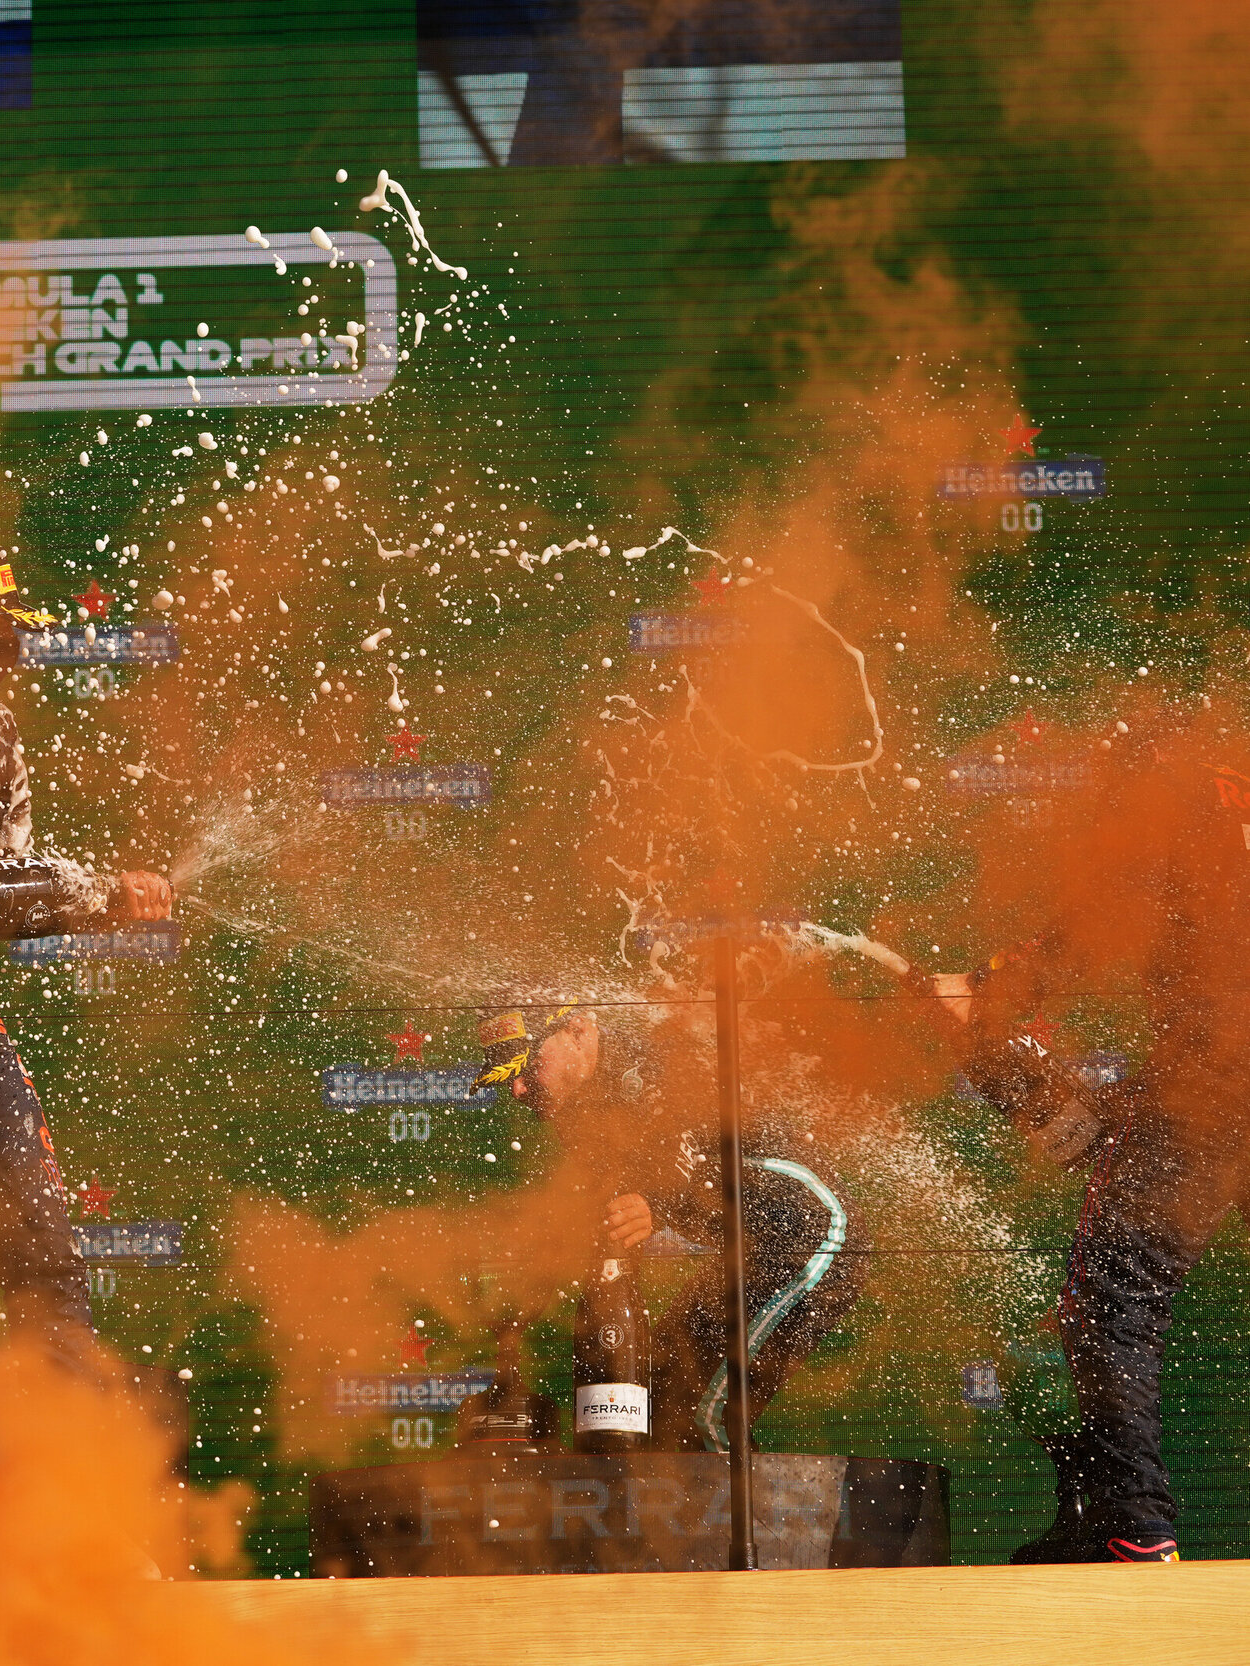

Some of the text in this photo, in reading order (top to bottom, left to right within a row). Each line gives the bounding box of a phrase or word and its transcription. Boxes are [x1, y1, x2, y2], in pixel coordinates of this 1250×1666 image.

[136, 274, 164, 304] 1
[55, 339, 232, 373] GRAND
[239, 336, 354, 370] PRIX
[605, 1329, 617, 1344] 3
[583, 1404, 641, 1416] FERRARI
